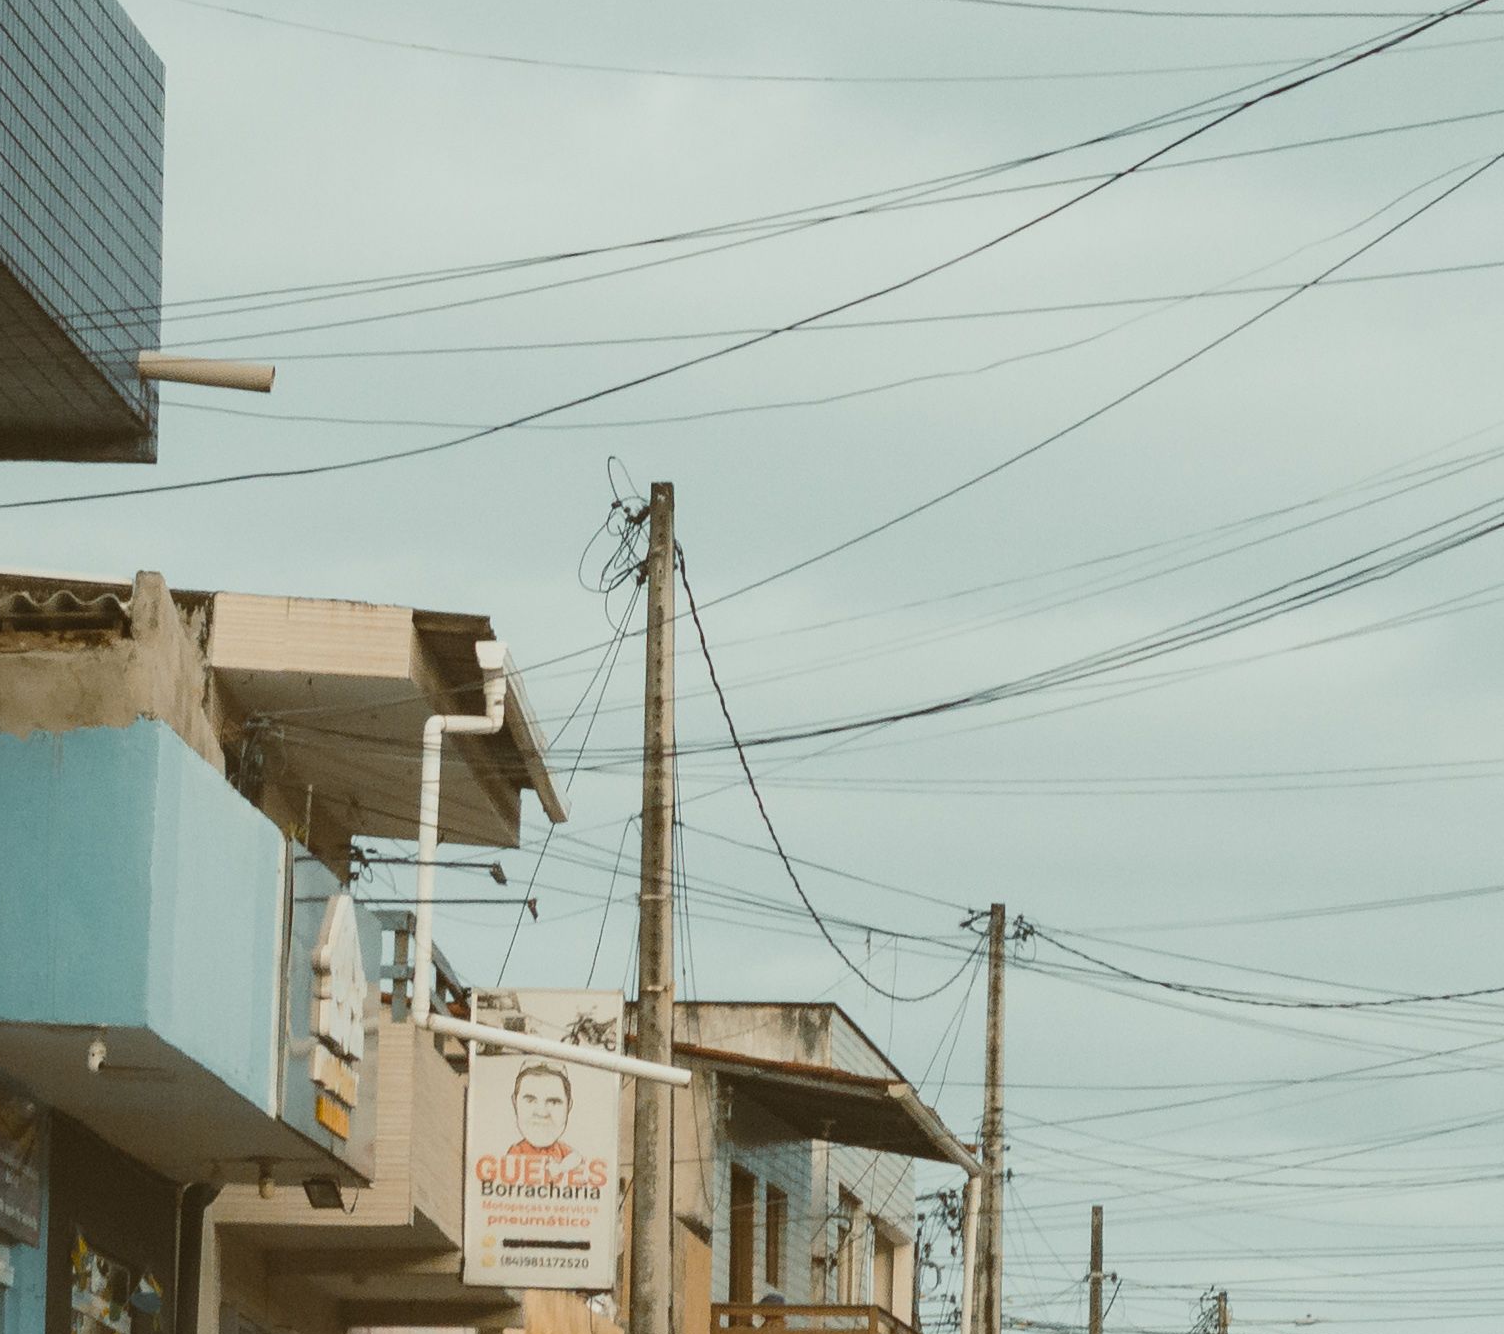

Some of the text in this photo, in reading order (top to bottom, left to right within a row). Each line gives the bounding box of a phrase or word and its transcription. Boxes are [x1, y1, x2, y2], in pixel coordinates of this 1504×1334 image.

[480, 1180, 601, 1200] Borracharia
[487, 1215, 591, 1228] pneumático
[500, 1254, 590, 1270] (84)981172520
